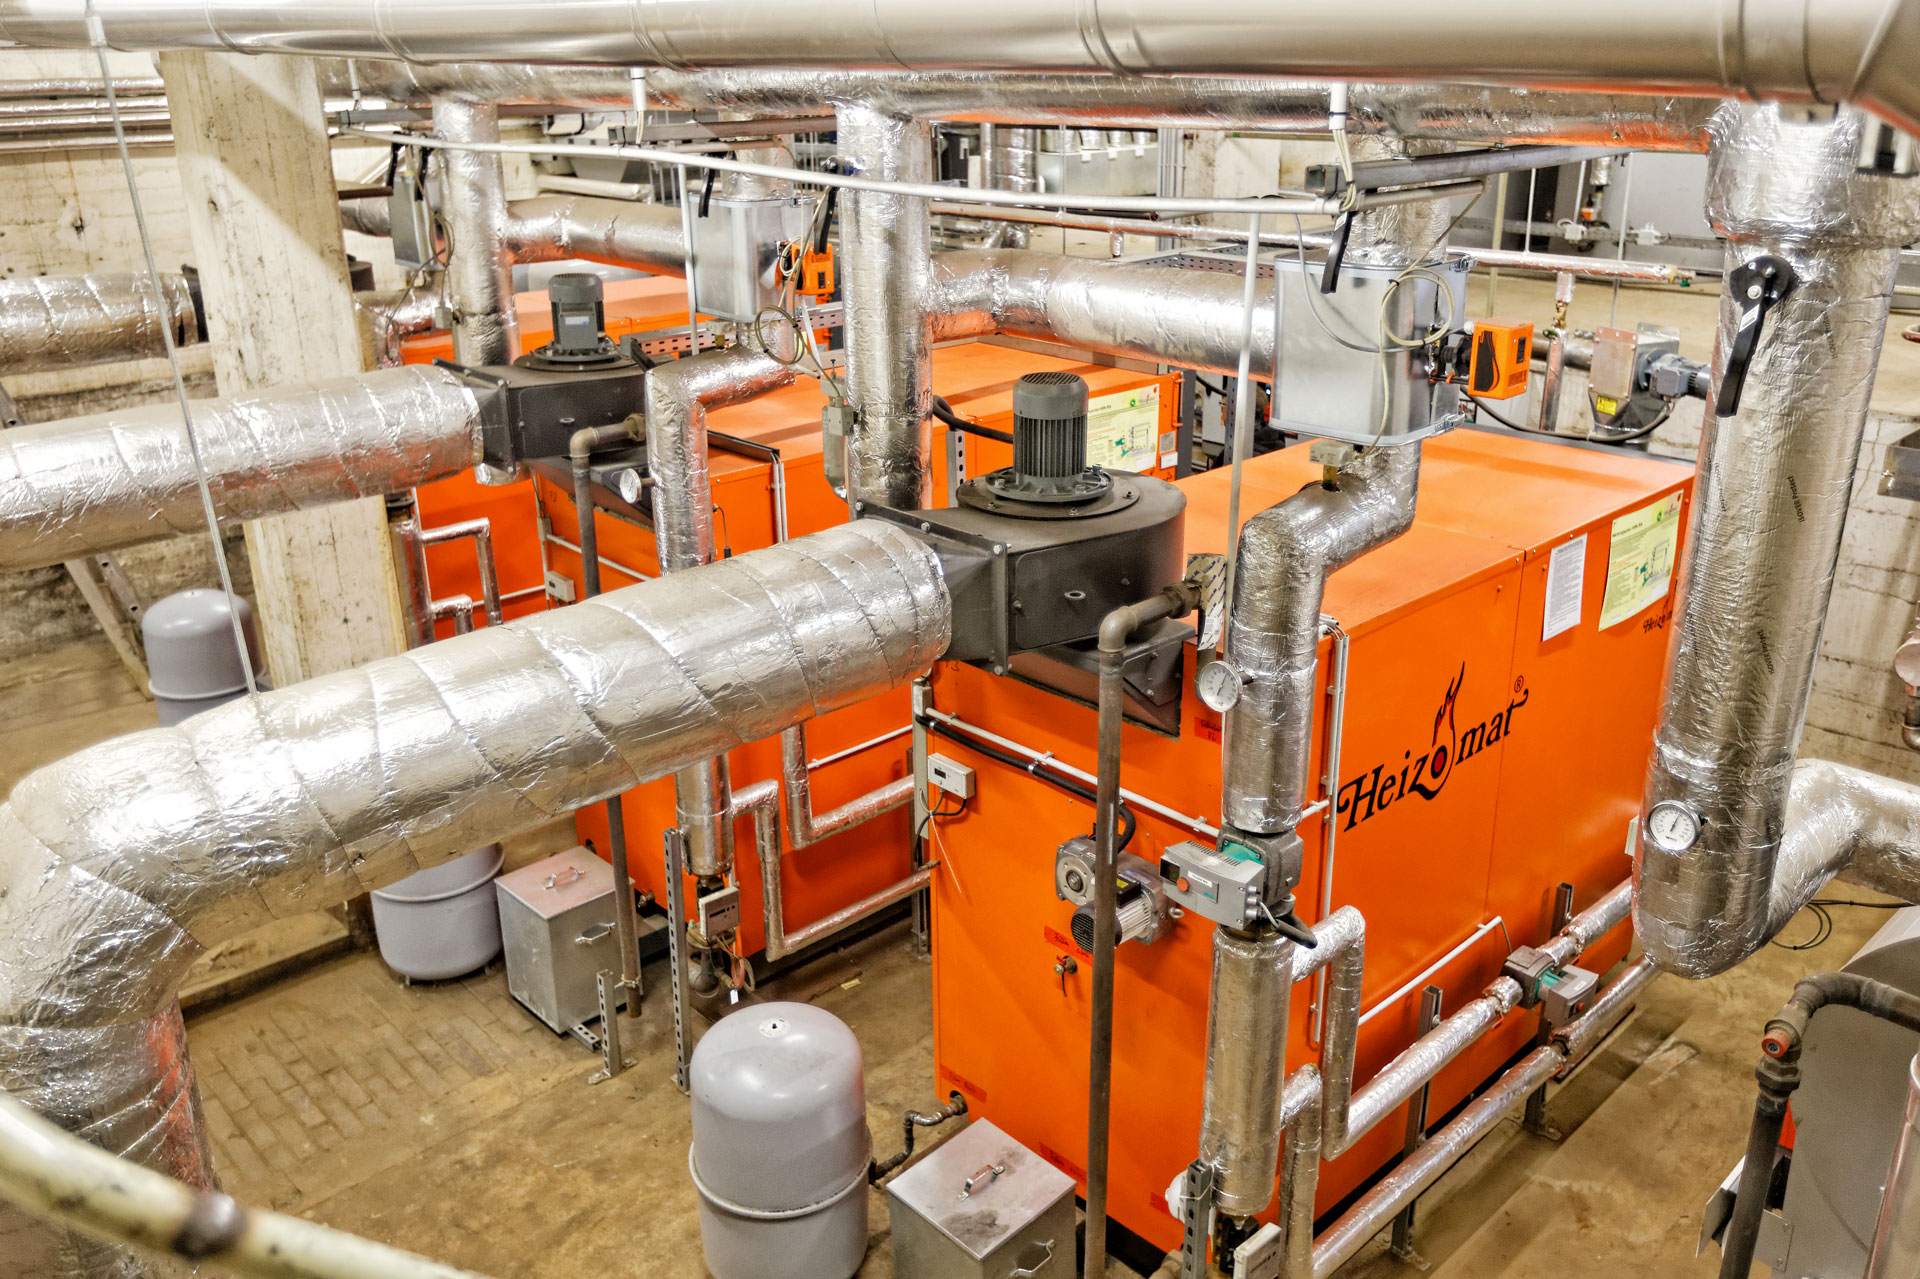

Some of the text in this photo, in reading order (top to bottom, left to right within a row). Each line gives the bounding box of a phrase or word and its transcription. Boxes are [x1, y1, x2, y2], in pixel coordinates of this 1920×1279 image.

[1787, 475, 1805, 523] ISOVER Protect
[1336, 686, 1529, 833] Heizomat
